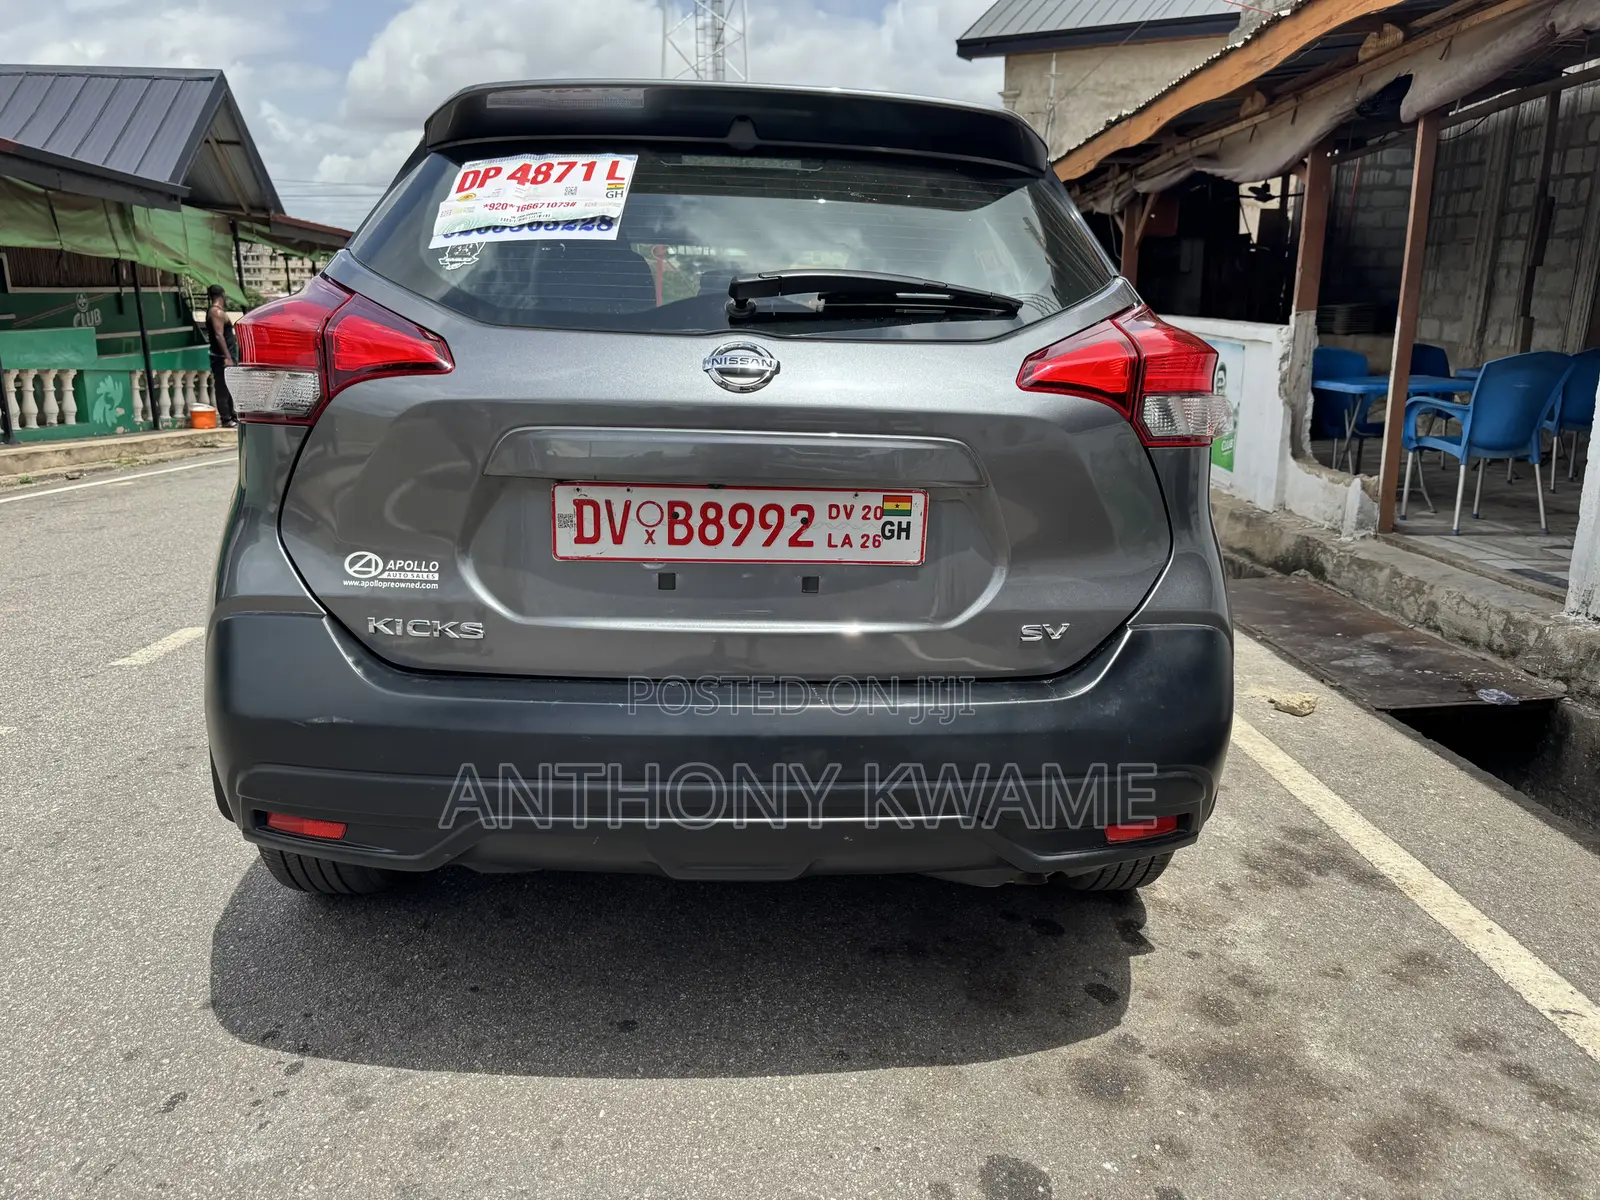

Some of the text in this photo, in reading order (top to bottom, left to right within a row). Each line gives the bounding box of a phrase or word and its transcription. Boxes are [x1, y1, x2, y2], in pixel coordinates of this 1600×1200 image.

[455, 166, 503, 194] DP
[506, 160, 598, 186] 4871
[605, 160, 626, 181] L
[605, 190, 624, 199] GH
[73, 308, 103, 328] CLUB
[711, 357, 773, 368] NISSAN
[827, 503, 884, 521] DV 20
[573, 499, 632, 545] DV
[667, 500, 816, 548] B8992
[880, 521, 912, 541] GH
[827, 533, 882, 549] LA 26
[385, 559, 440, 572] APOLLO
[342, 580, 439, 590] www.apollopreowned.com
[367, 616, 485, 640] KICKS
[1020, 623, 1070, 642] SV
